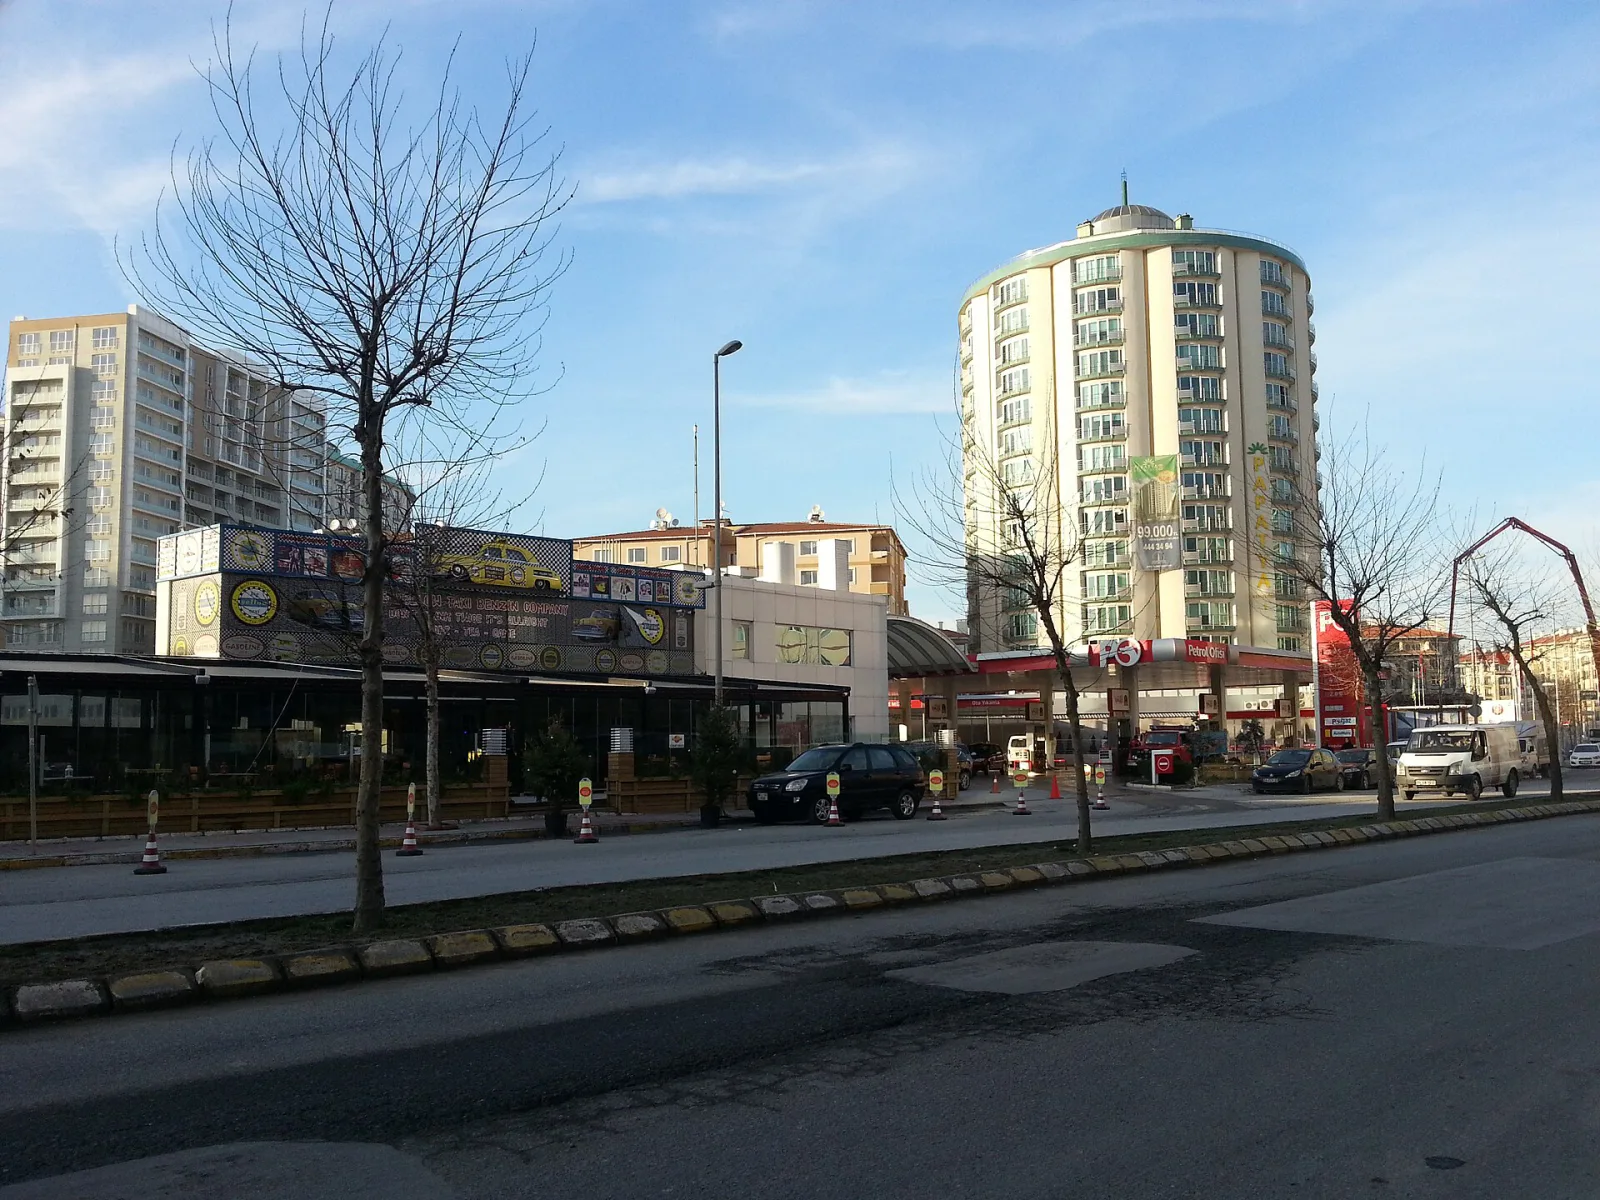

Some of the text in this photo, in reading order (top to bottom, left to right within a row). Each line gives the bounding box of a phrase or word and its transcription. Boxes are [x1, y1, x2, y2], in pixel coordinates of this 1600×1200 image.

[1253, 456, 1270, 588] PAPATYA
[1137, 524, 1173, 538] 99.000
[524, 602, 569, 616] COMPANY
[1188, 644, 1225, 659] Petrol Ofisi
